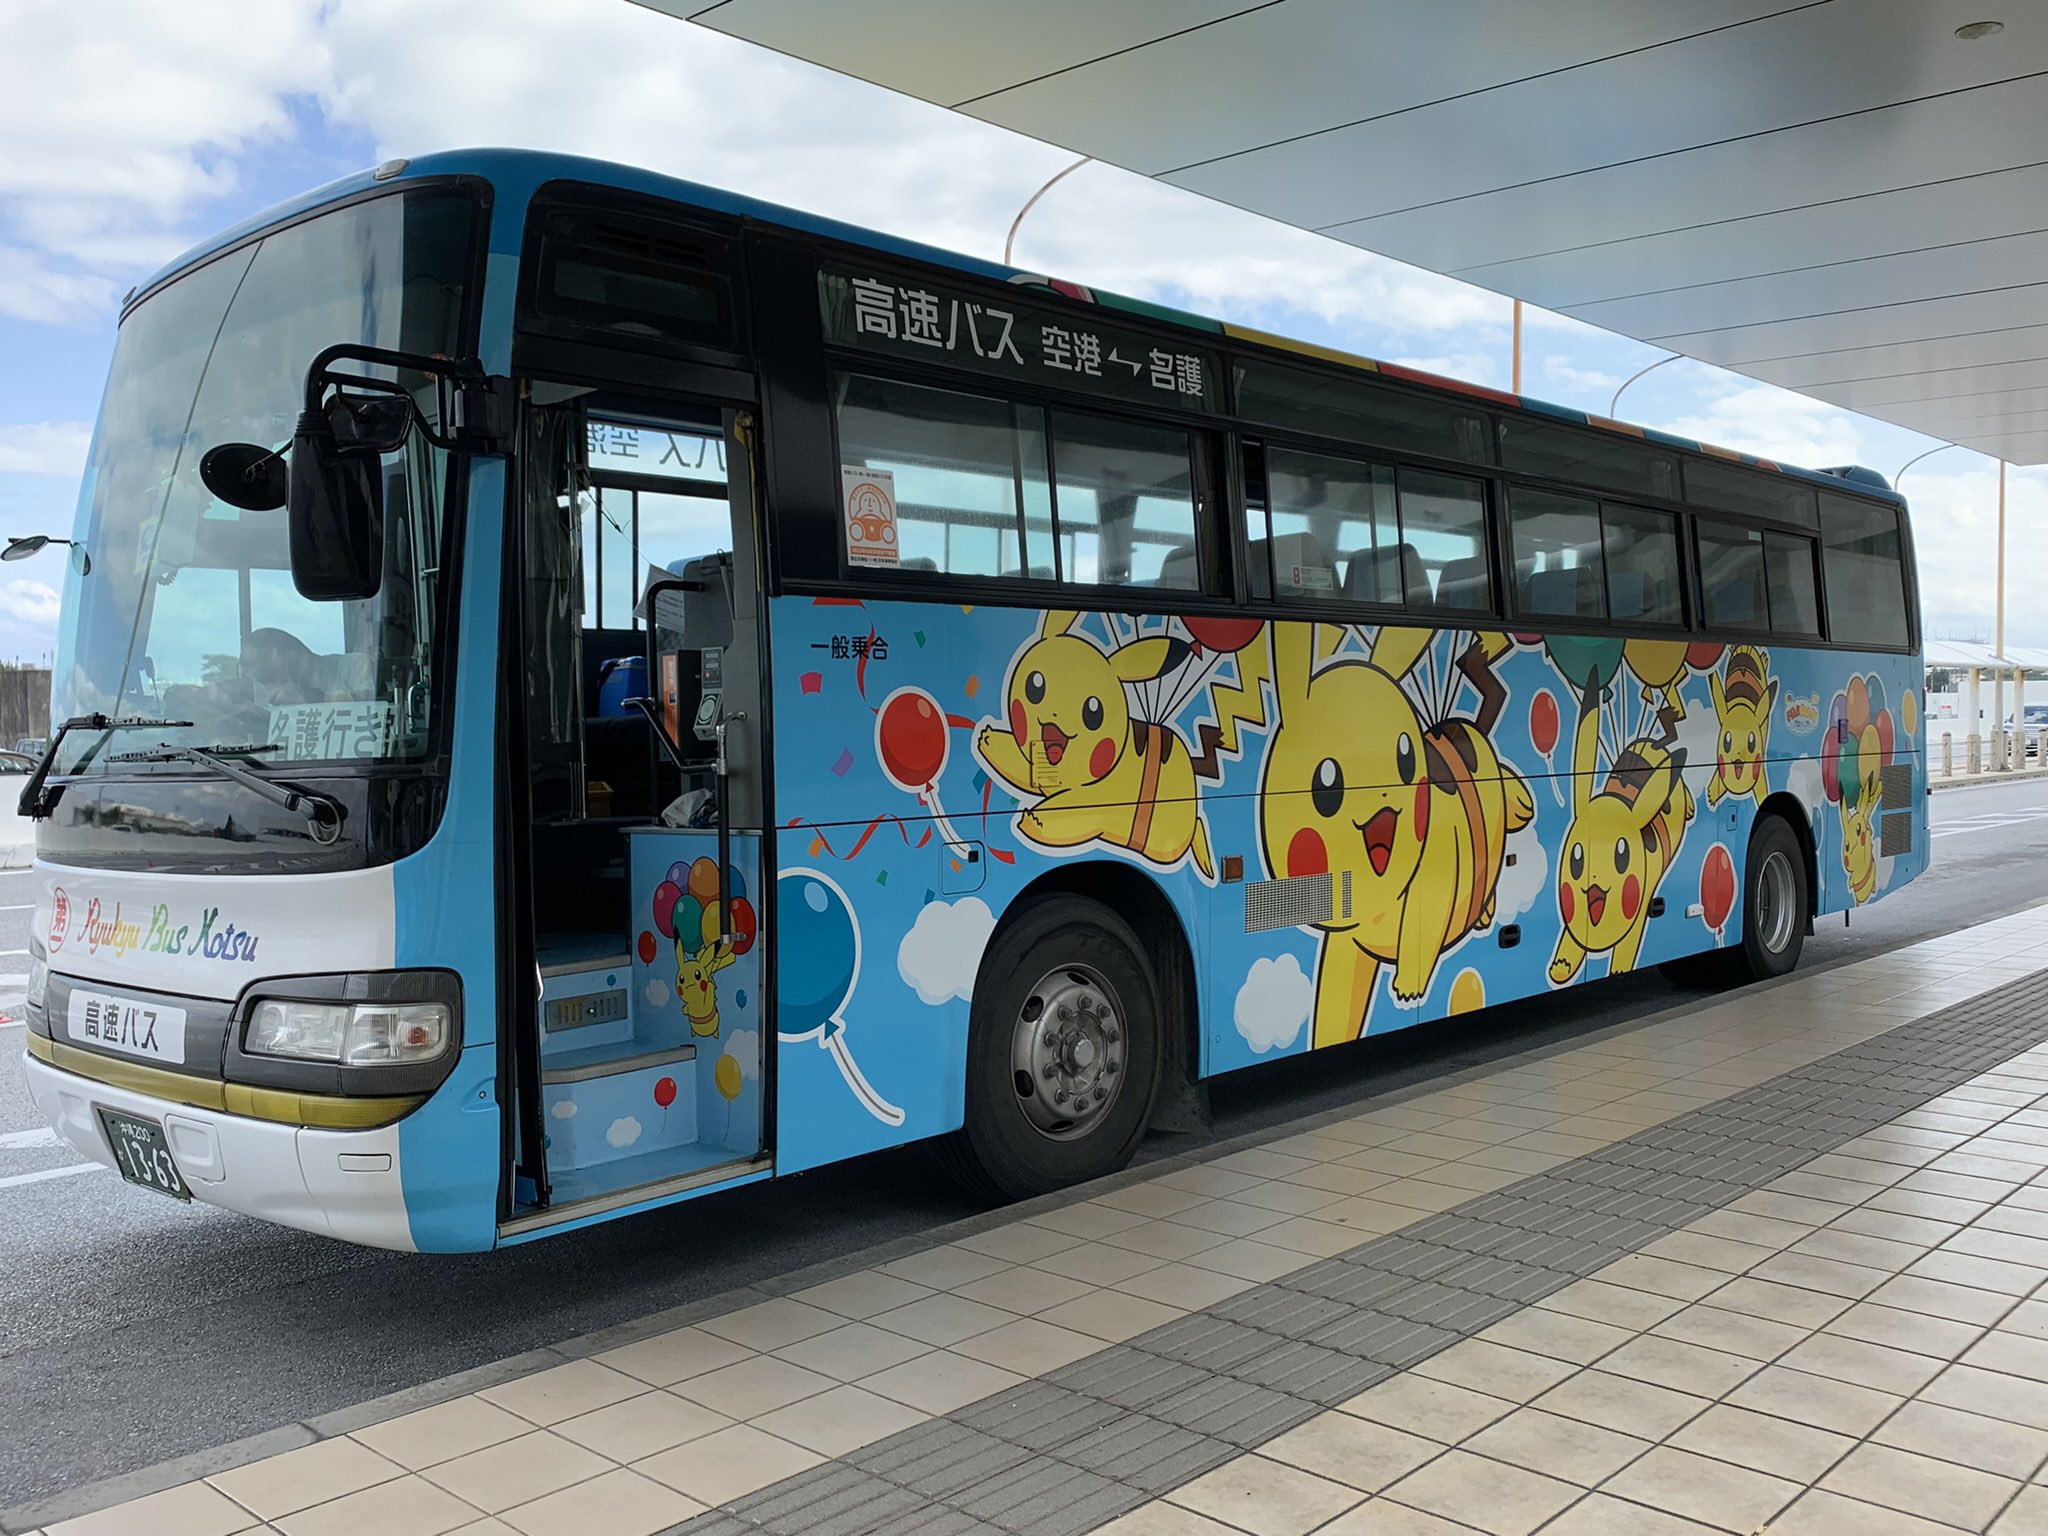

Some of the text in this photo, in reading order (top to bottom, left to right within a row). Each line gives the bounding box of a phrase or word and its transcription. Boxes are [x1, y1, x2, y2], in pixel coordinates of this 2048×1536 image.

[852, 278, 1203, 397] 高速バス 空港 名護
[811, 634, 888, 660] 一般乗合
[271, 705, 382, 760] 名護行き
[77, 897, 259, 962] Ryukyu Bus Kotsu
[85, 1000, 158, 1052] 高速バス
